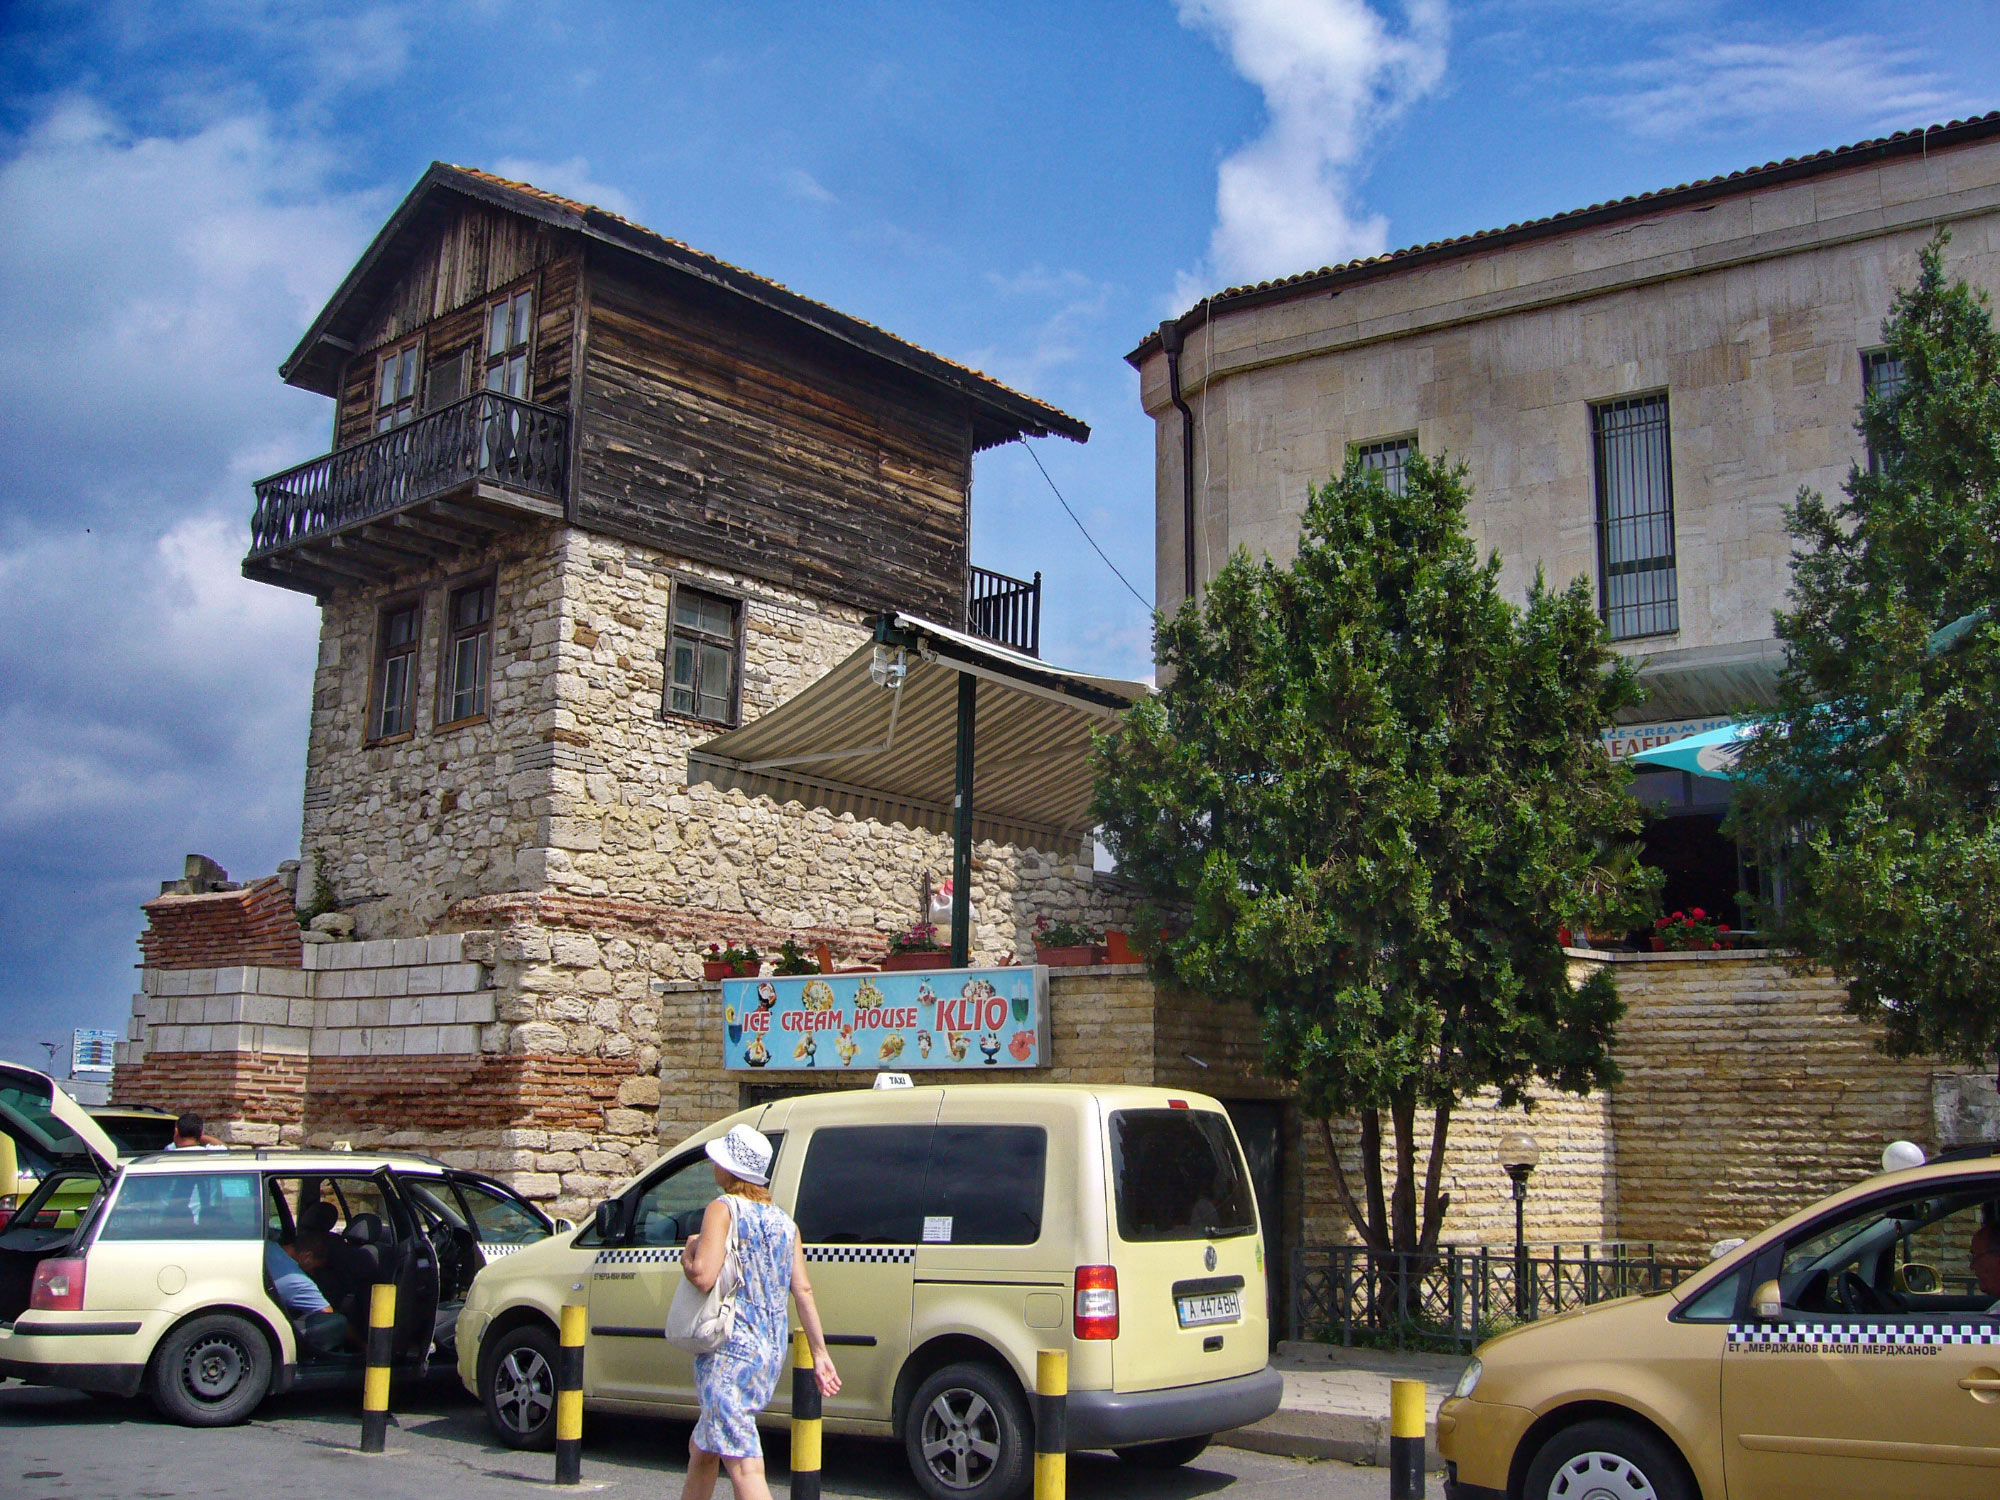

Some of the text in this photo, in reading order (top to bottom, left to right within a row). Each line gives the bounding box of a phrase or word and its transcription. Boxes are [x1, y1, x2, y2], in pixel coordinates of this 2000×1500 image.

[744, 997, 1008, 1033] ICE CREAM HOUSE KLIO
[889, 1076, 906, 1085] TAXI
[1728, 1343, 1741, 1353] ЕТ
[1822, 1344, 1859, 1354] ВАСИЛ
